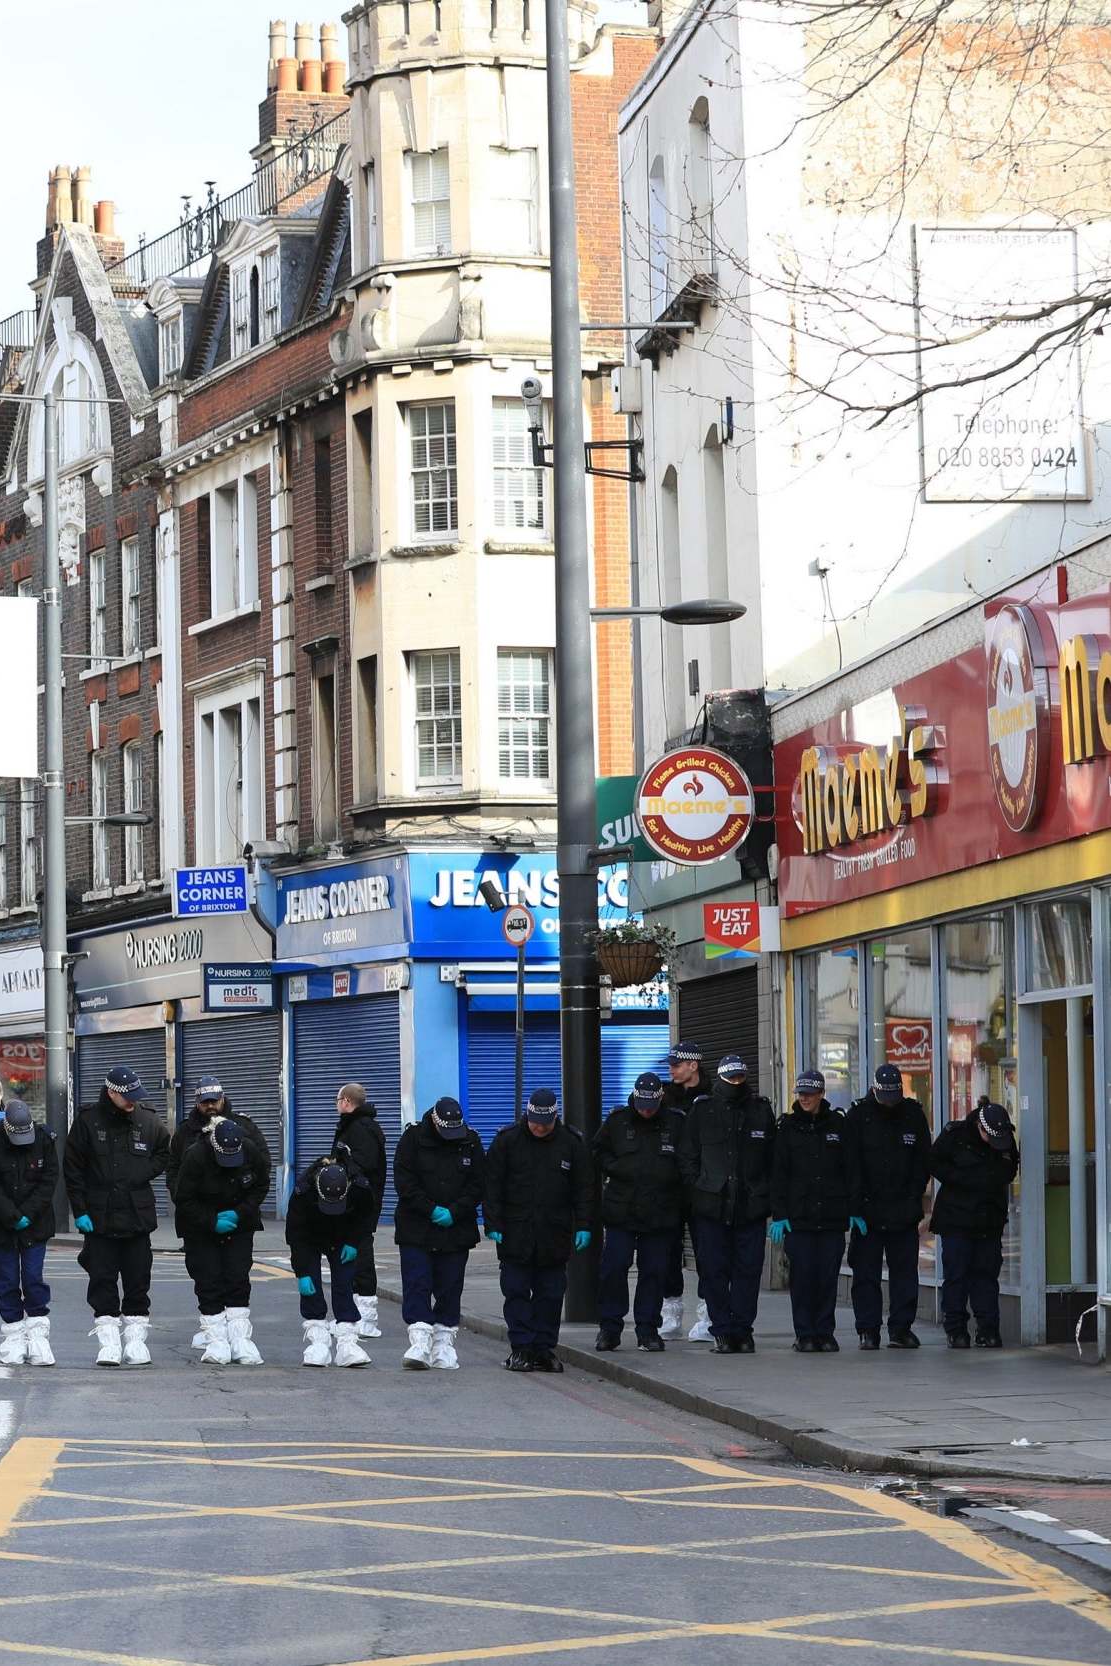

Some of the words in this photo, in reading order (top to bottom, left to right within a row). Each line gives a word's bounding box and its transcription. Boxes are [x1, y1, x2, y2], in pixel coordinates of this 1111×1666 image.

[980, 313, 1054, 329] EQUIRIES
[953, 413, 1058, 439] Telephone:
[937, 447, 972, 467] 020
[978, 447, 1024, 467] 8853
[1031, 446, 1078, 468] 0424
[652, 766, 675, 790] Flame
[675, 757, 707, 770] Grilled
[708, 761, 737, 790] Chicken
[800, 703, 928, 856] Maeme's
[647, 797, 746, 815] Maeme's
[646, 818, 659, 834] Eat
[659, 834, 692, 857] Healthy
[697, 843, 715, 855] Live
[717, 817, 745, 846] Healthy
[833, 859, 856, 881] HEALTHY
[900, 837, 916, 861] FOOD
[186, 870, 237, 886] JEANS
[178, 886, 244, 902] CORNER
[429, 869, 560, 907] JEANS
[189, 904, 200, 912] OF
[201, 903, 237, 912] BRIXTON
[284, 885, 329, 925] JEANS
[329, 875, 392, 919] CORNER
[712, 907, 751, 924] JUST
[322, 931, 332, 946] OF
[332, 927, 358, 945] BRIXTON
[720, 922, 751, 936] EAT
[134, 933, 177, 969] NURSING
[179, 929, 203, 961] 2000
[215, 968, 251, 978] NURSING
[253, 968, 272, 977] 2000
[223, 985, 258, 997] medic
